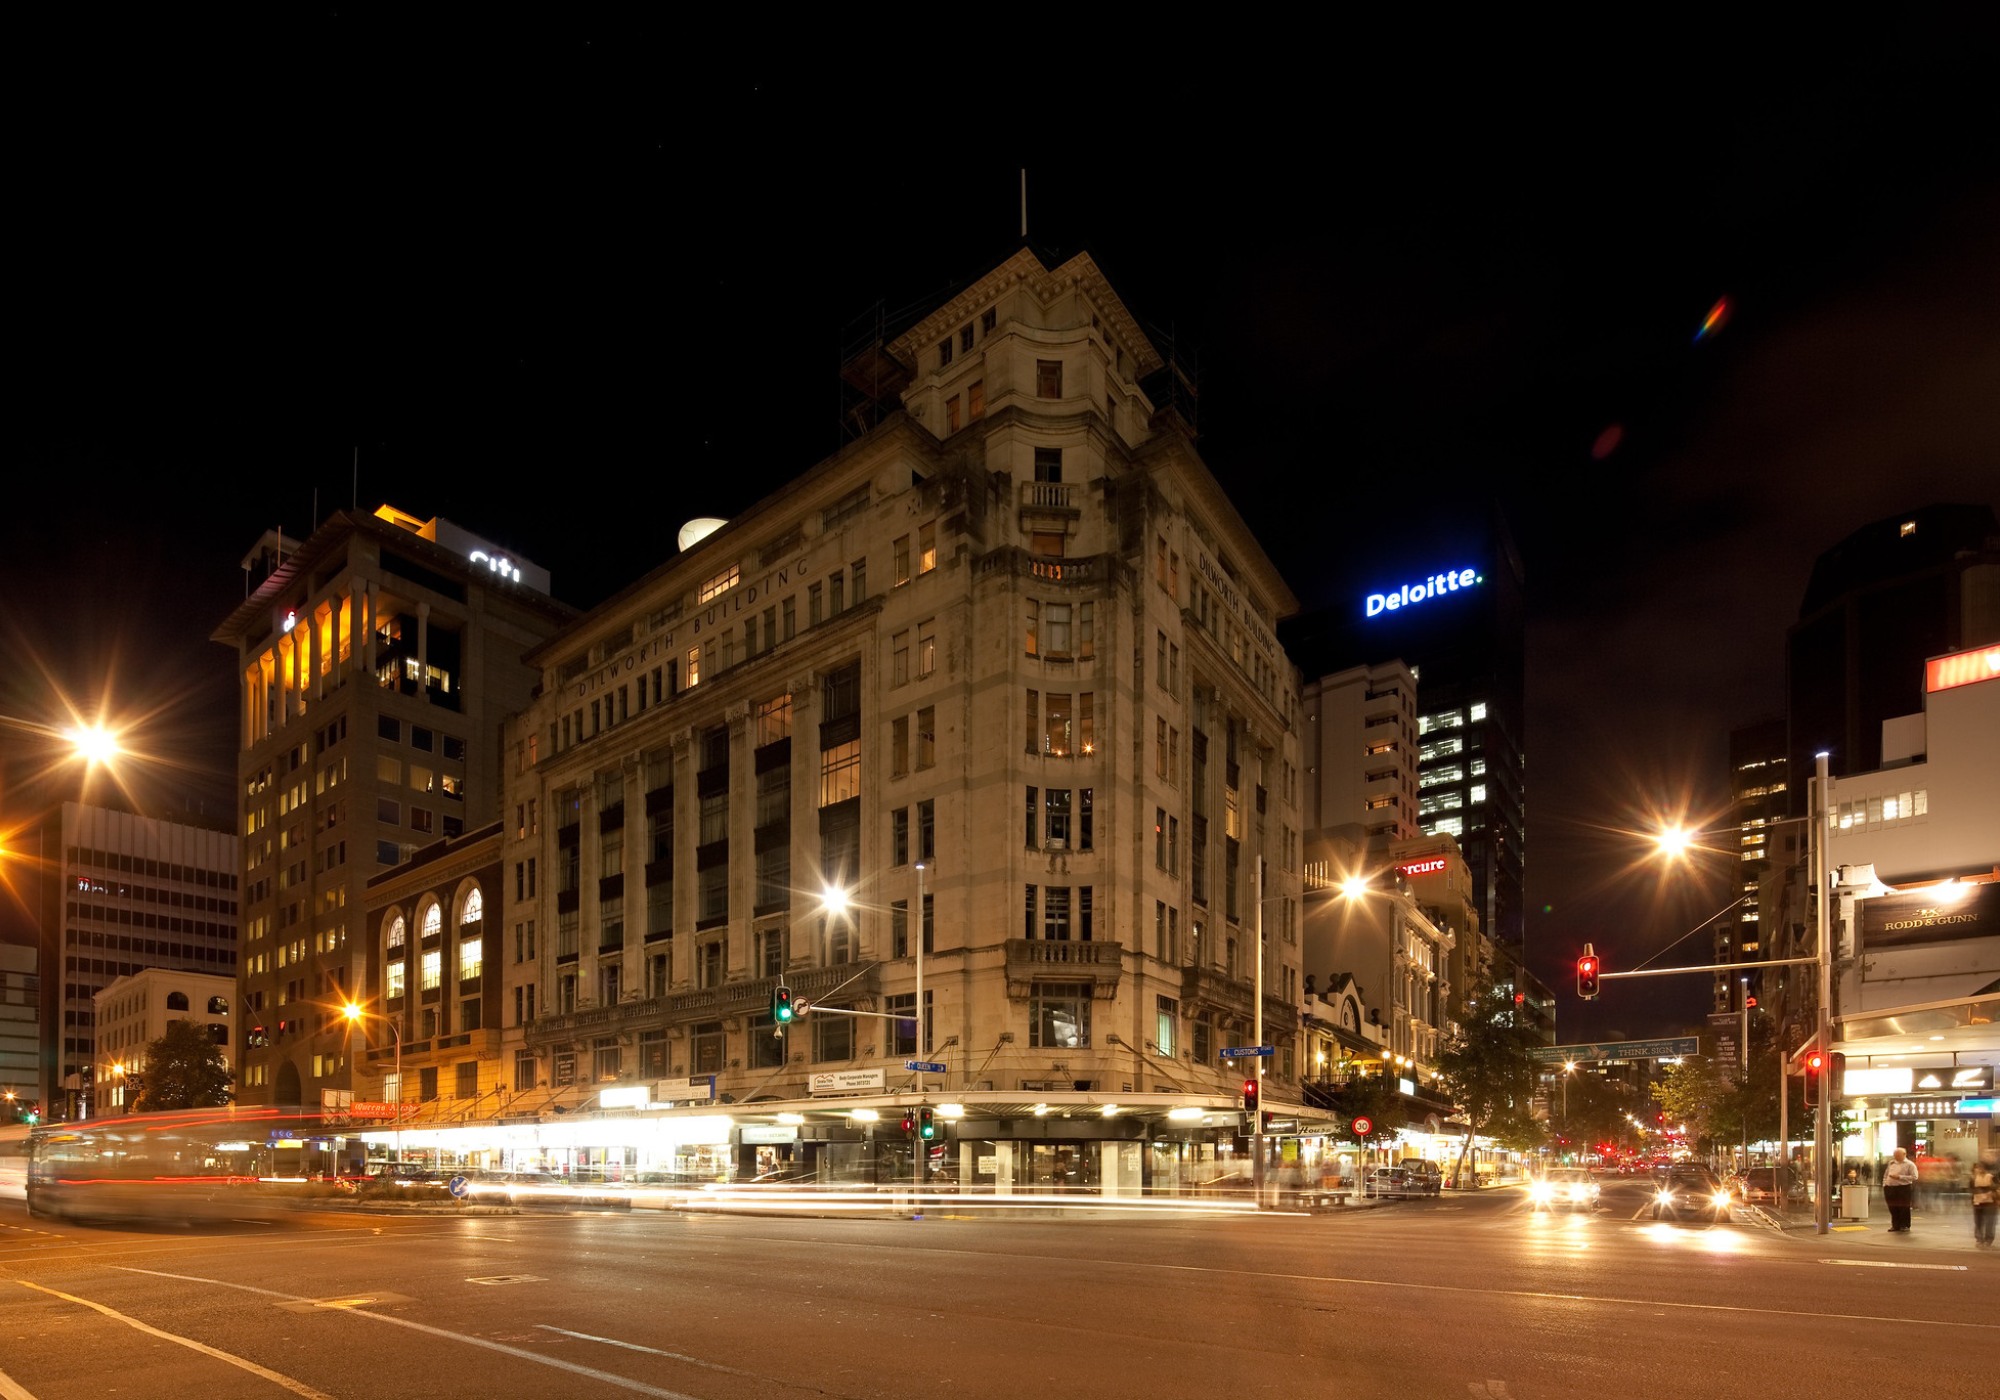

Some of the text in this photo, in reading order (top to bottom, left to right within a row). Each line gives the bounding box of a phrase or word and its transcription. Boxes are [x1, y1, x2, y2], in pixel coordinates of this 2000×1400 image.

[1366, 568, 1483, 618] Deloitte.
[1199, 552, 1274, 659] DILWORTH BUILDING
[578, 558, 809, 698] DILWORTH BUILDING
[1884, 913, 1979, 931] RODD & GUNN
[1233, 1048, 1259, 1056] CUSTOMS
[916, 1062, 932, 1071] QUEEN
[606, 1110, 641, 1119] SOUVENIRS
[1356, 1122, 1369, 1131] 30
